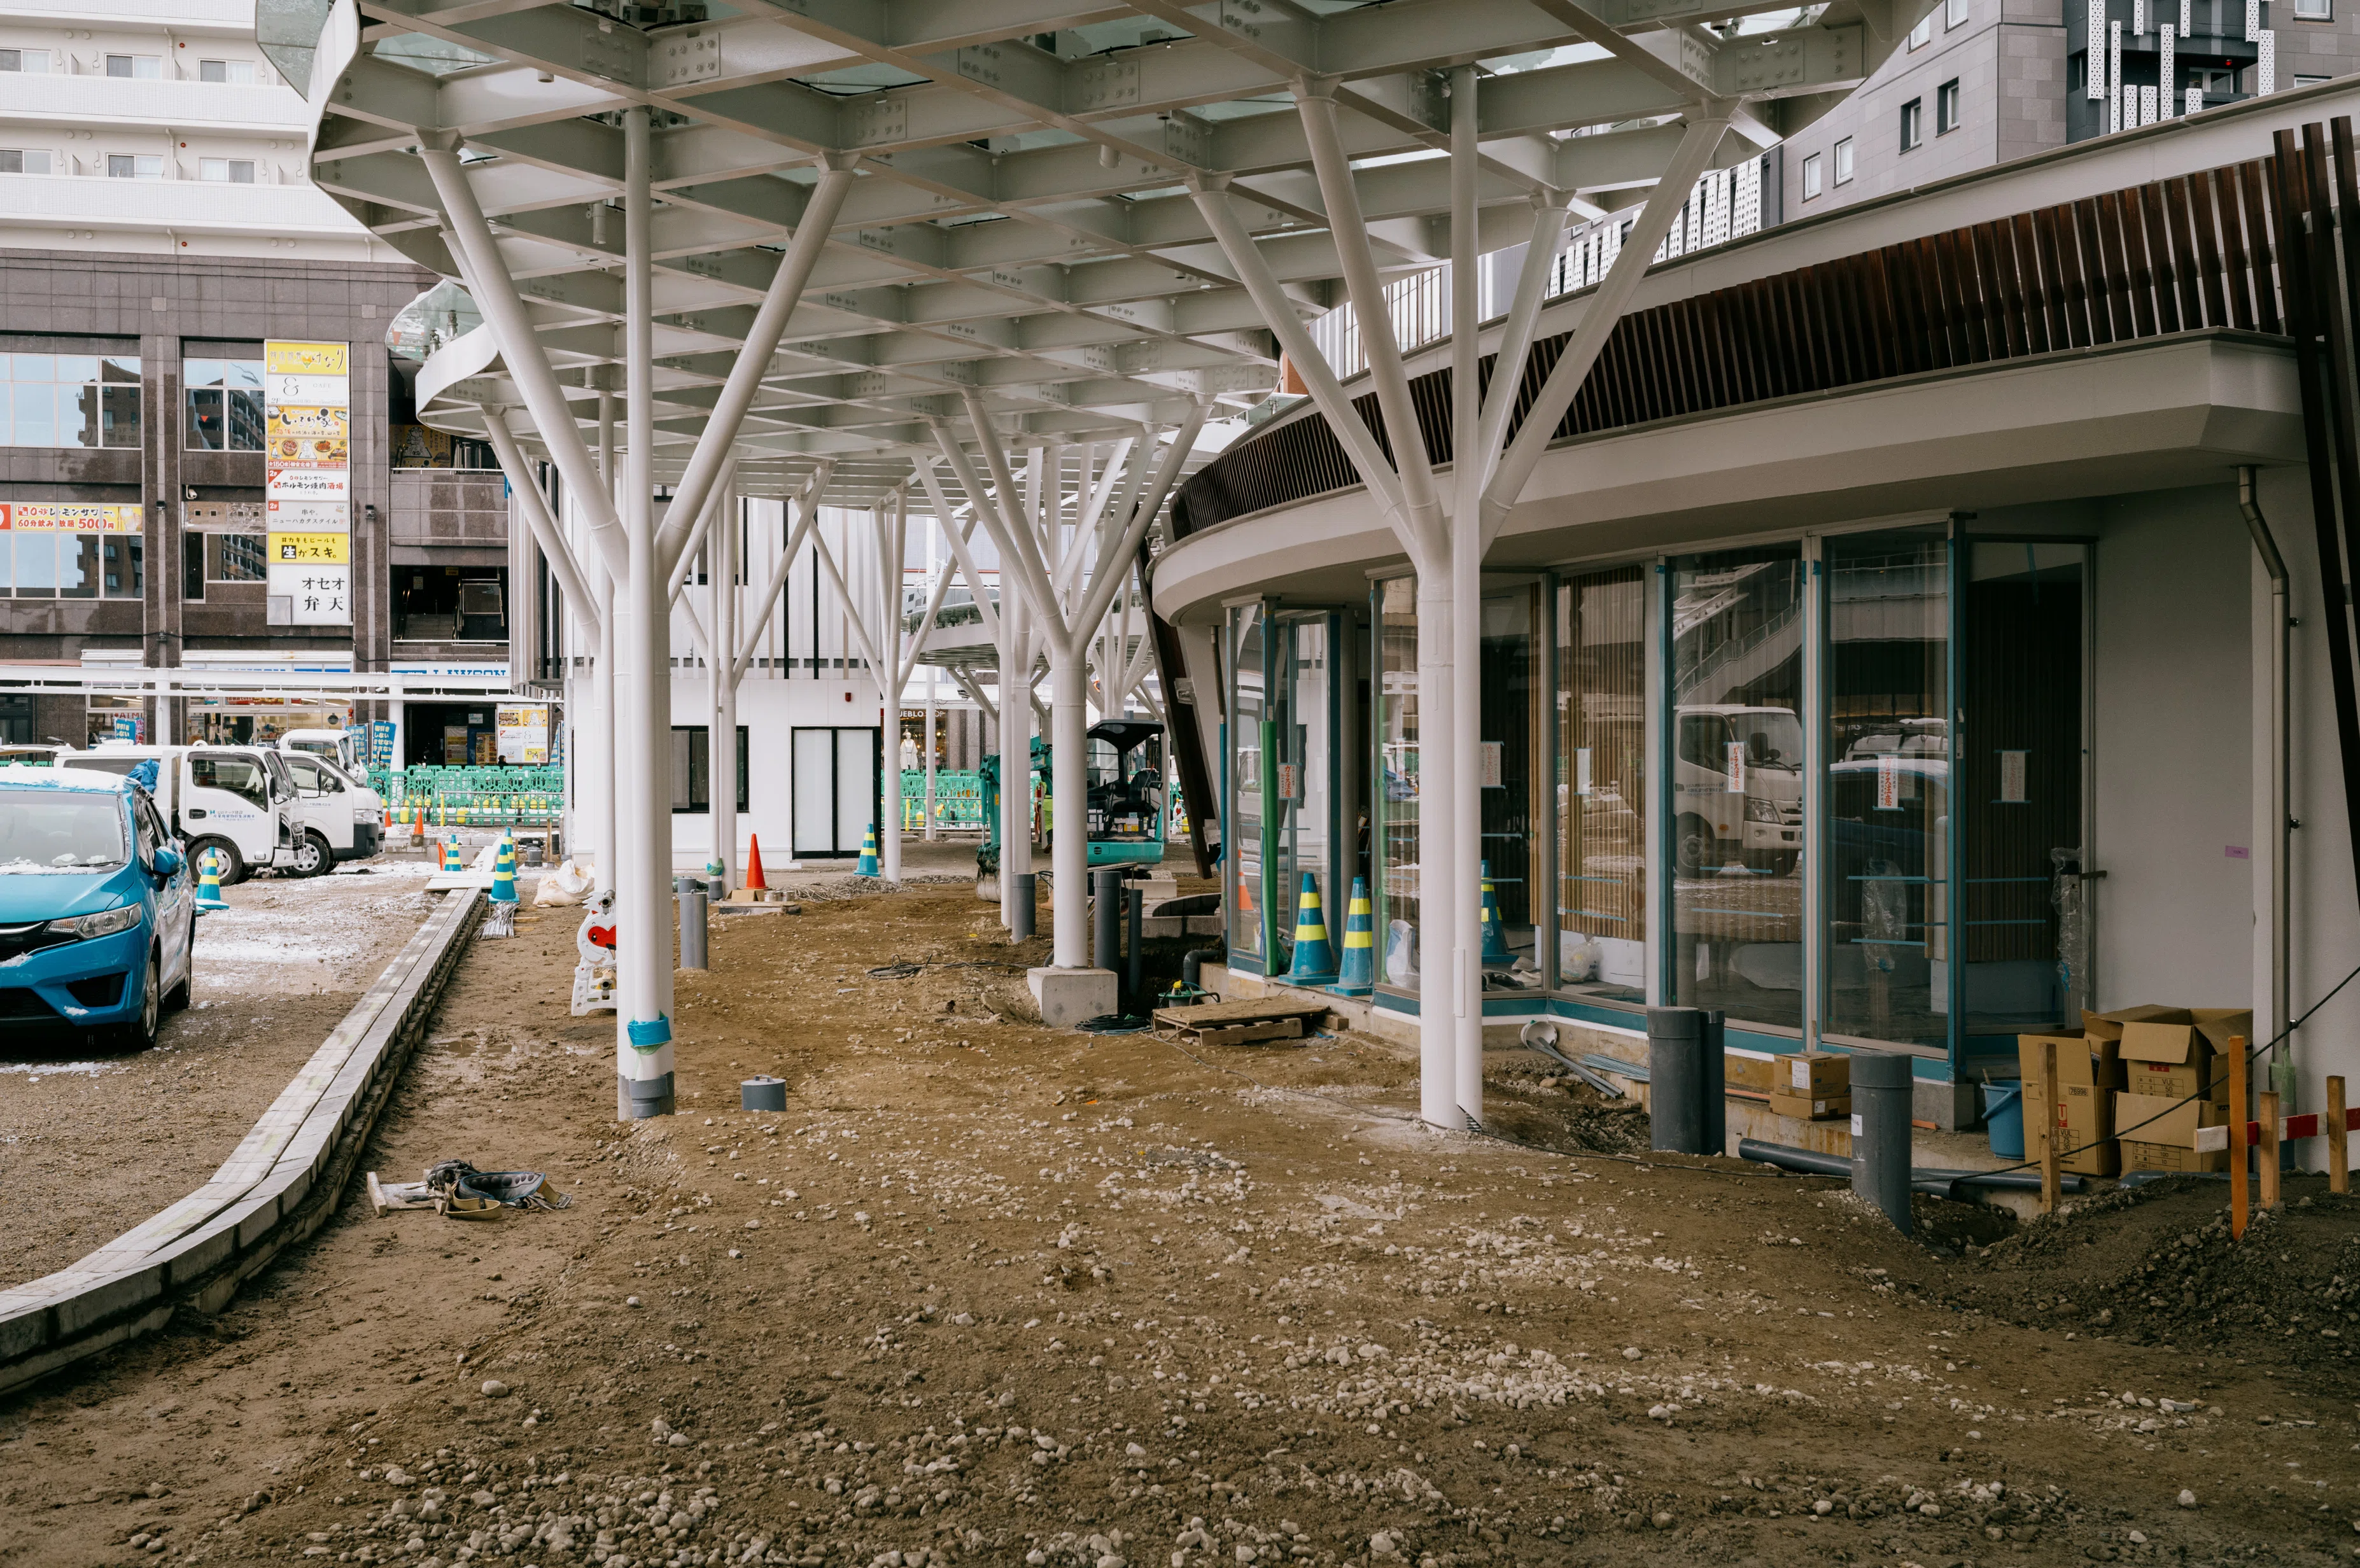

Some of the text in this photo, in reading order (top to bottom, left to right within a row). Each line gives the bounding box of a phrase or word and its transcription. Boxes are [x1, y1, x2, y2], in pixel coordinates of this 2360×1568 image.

[302, 577, 345, 591] オセオ
[304, 596, 344, 612] 弁天
[1884, 757, 1893, 806] ガラス注意
